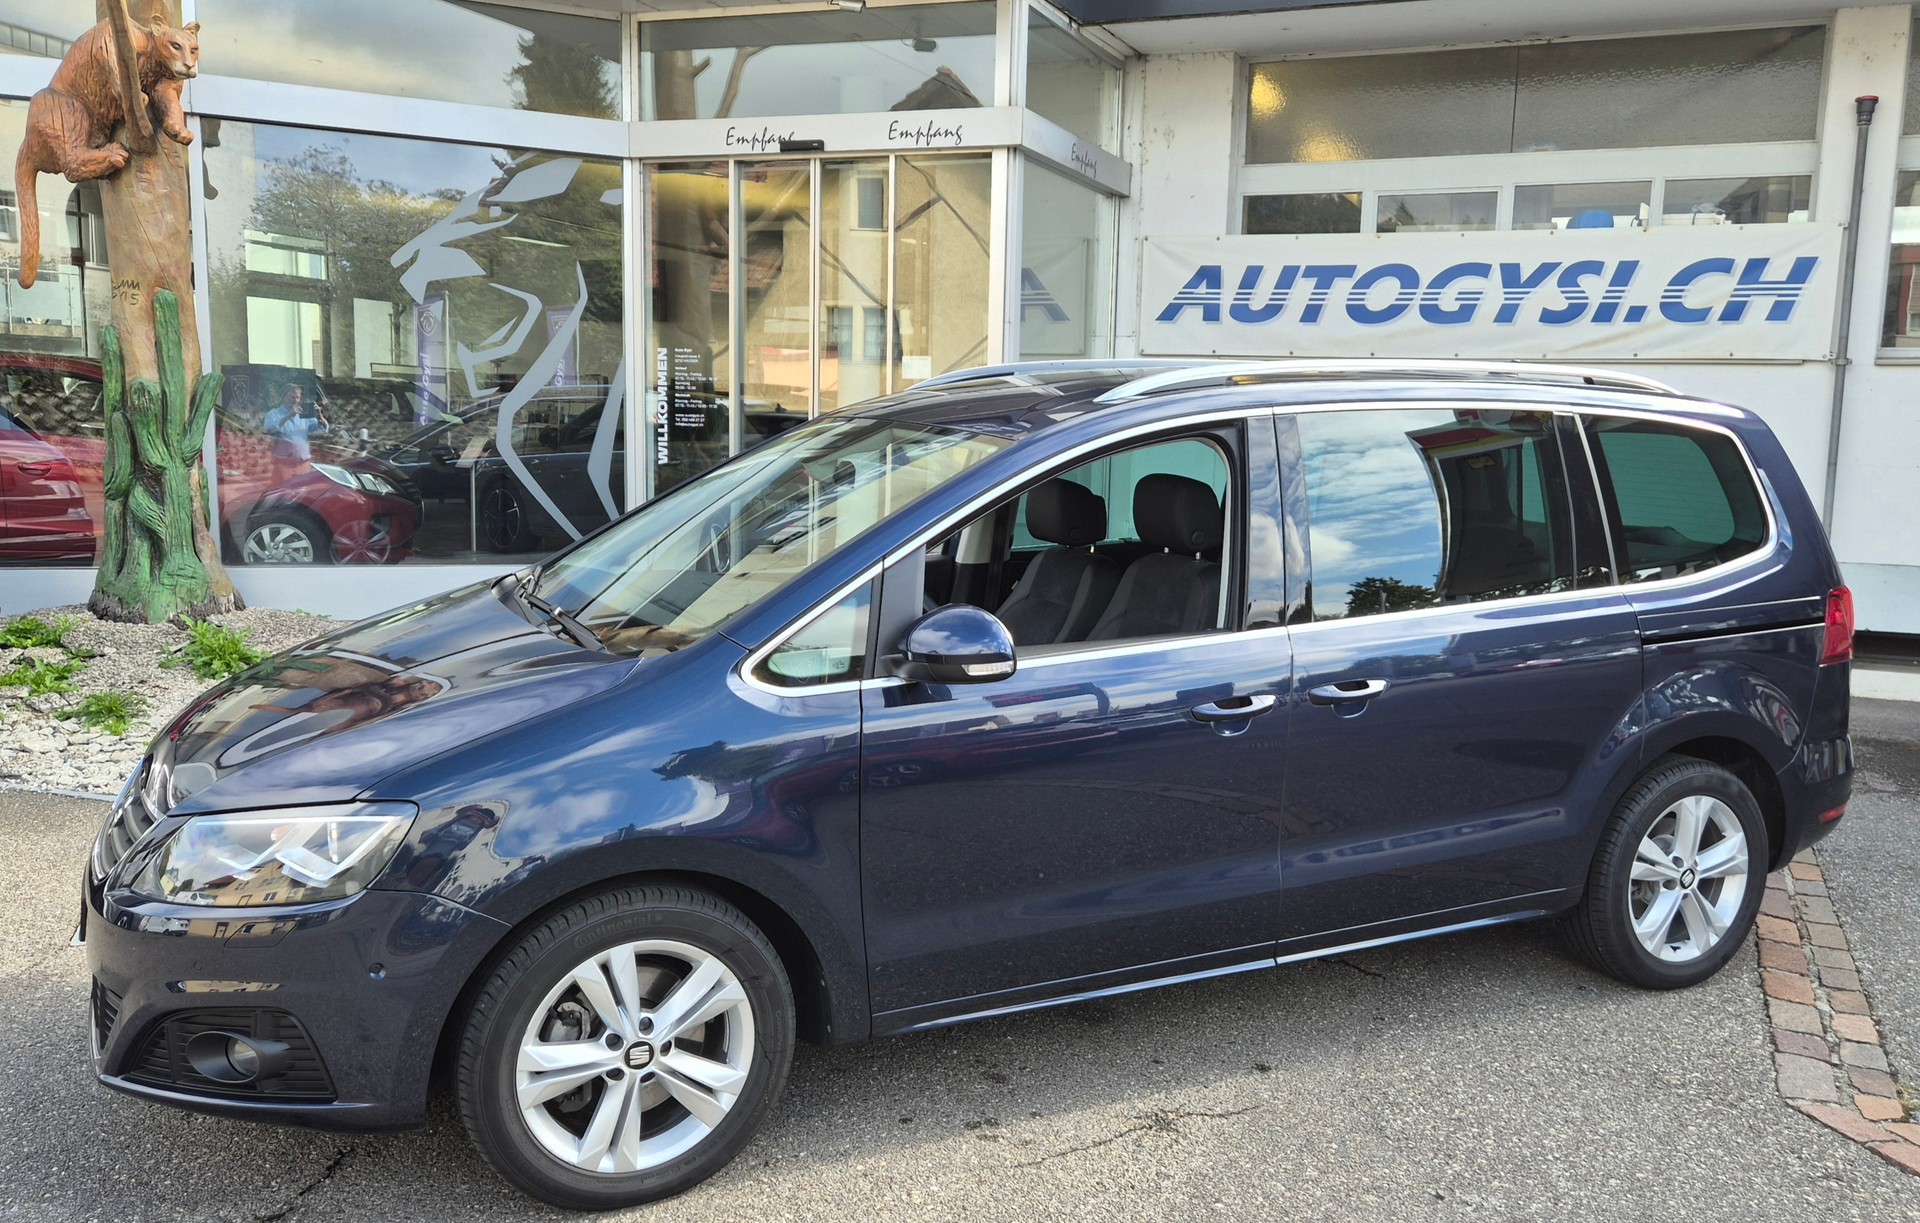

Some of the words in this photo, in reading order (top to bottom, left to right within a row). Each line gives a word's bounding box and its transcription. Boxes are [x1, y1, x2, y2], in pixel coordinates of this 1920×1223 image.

[888, 120, 963, 146] Empfang
[1071, 142, 1097, 178] Empfang
[1156, 256, 1819, 325] AUTOGYSI.CH
[657, 347, 669, 465] WILLKOMMEN
